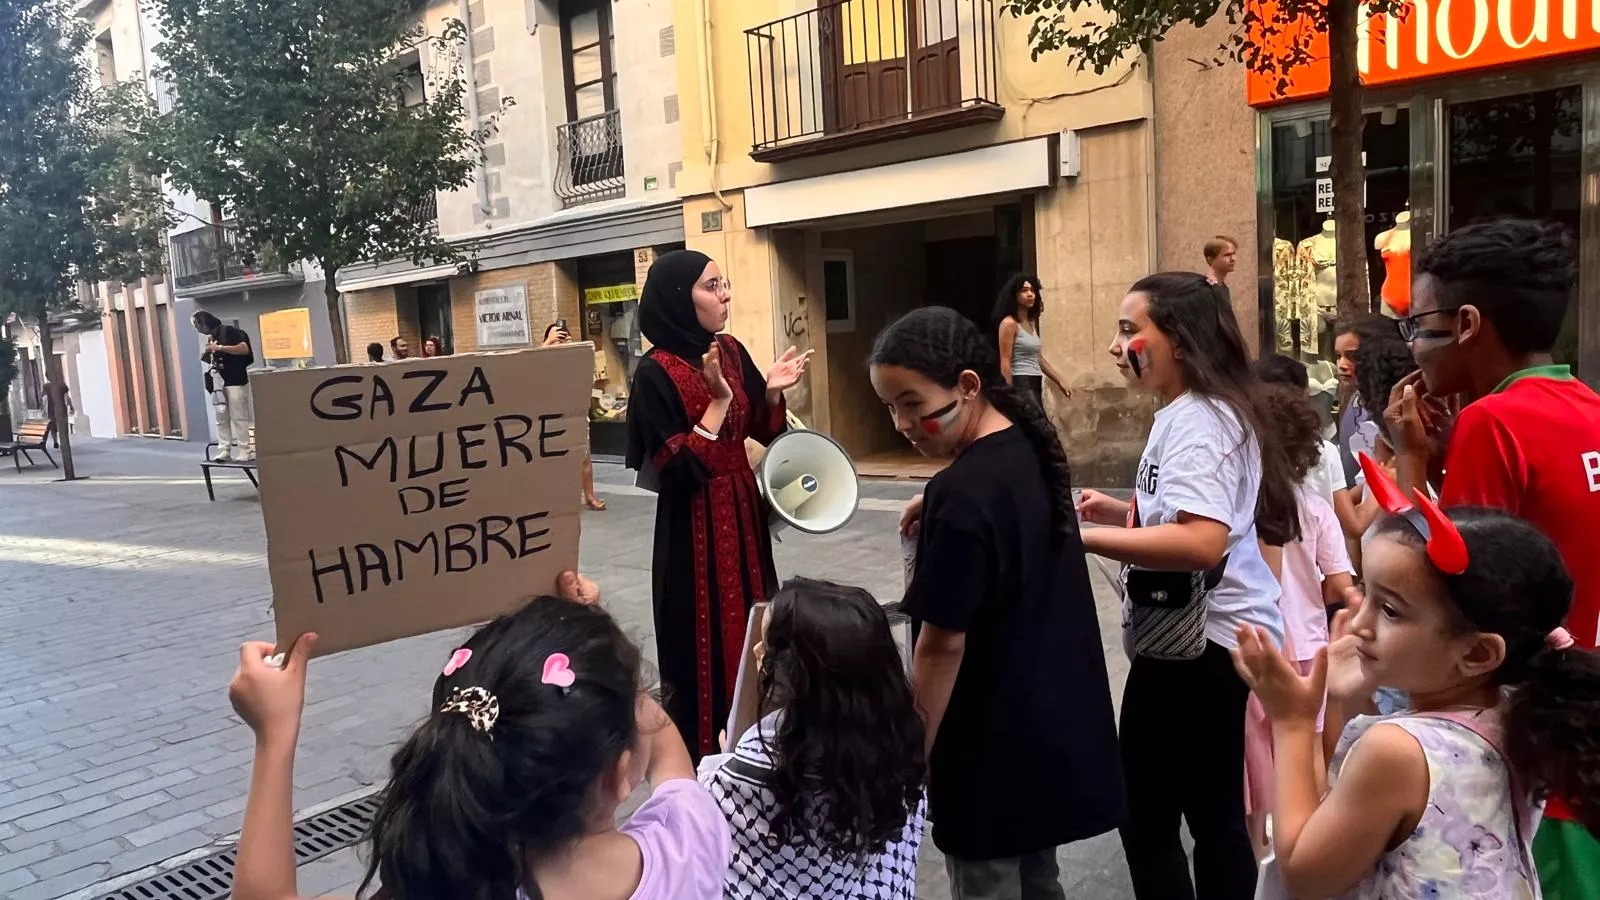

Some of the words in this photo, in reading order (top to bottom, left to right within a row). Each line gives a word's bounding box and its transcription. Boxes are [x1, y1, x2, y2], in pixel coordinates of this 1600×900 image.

[1319, 183, 1331, 194] RE
[1319, 197, 1331, 208] RE
[638, 251, 648, 263] 53
[310, 366, 495, 421] GAZA
[334, 413, 569, 487] MUERE
[398, 477, 470, 515] DE
[308, 511, 551, 604] HAMBRE
